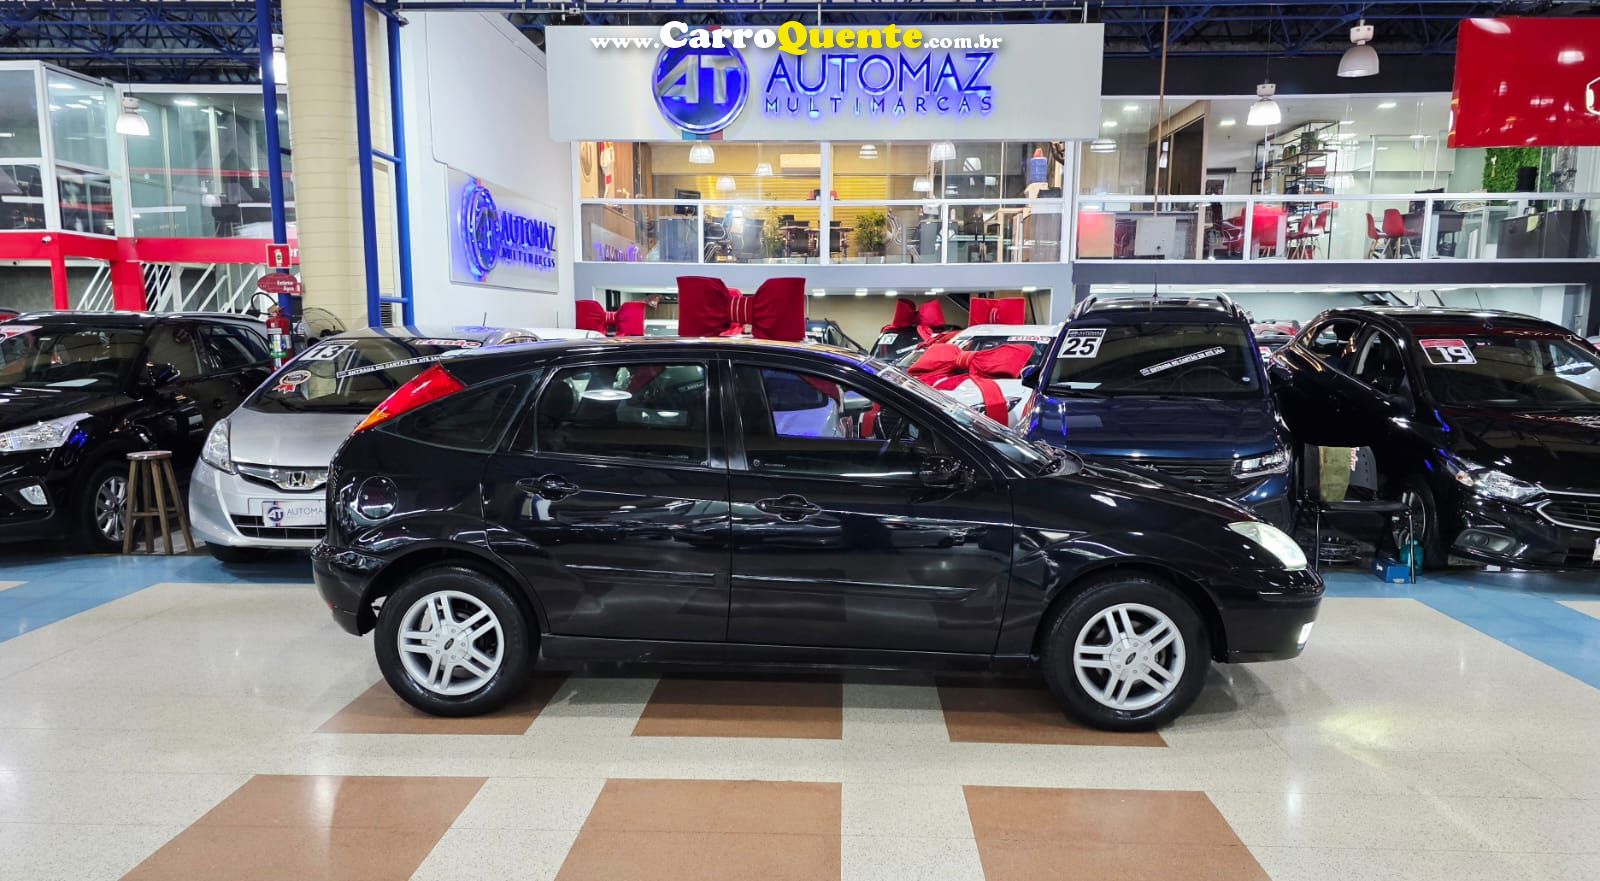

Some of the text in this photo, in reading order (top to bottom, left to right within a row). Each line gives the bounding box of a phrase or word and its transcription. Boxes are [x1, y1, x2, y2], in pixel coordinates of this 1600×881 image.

[766, 52, 994, 94] AUTOMAZ
[765, 96, 993, 113] MULTIMARCAS
[501, 210, 557, 252] AUTOMAZ
[310, 345, 344, 359] 13
[1062, 337, 1096, 356] 25
[1436, 346, 1474, 363] 19
[287, 506, 325, 516] AUTOMA
